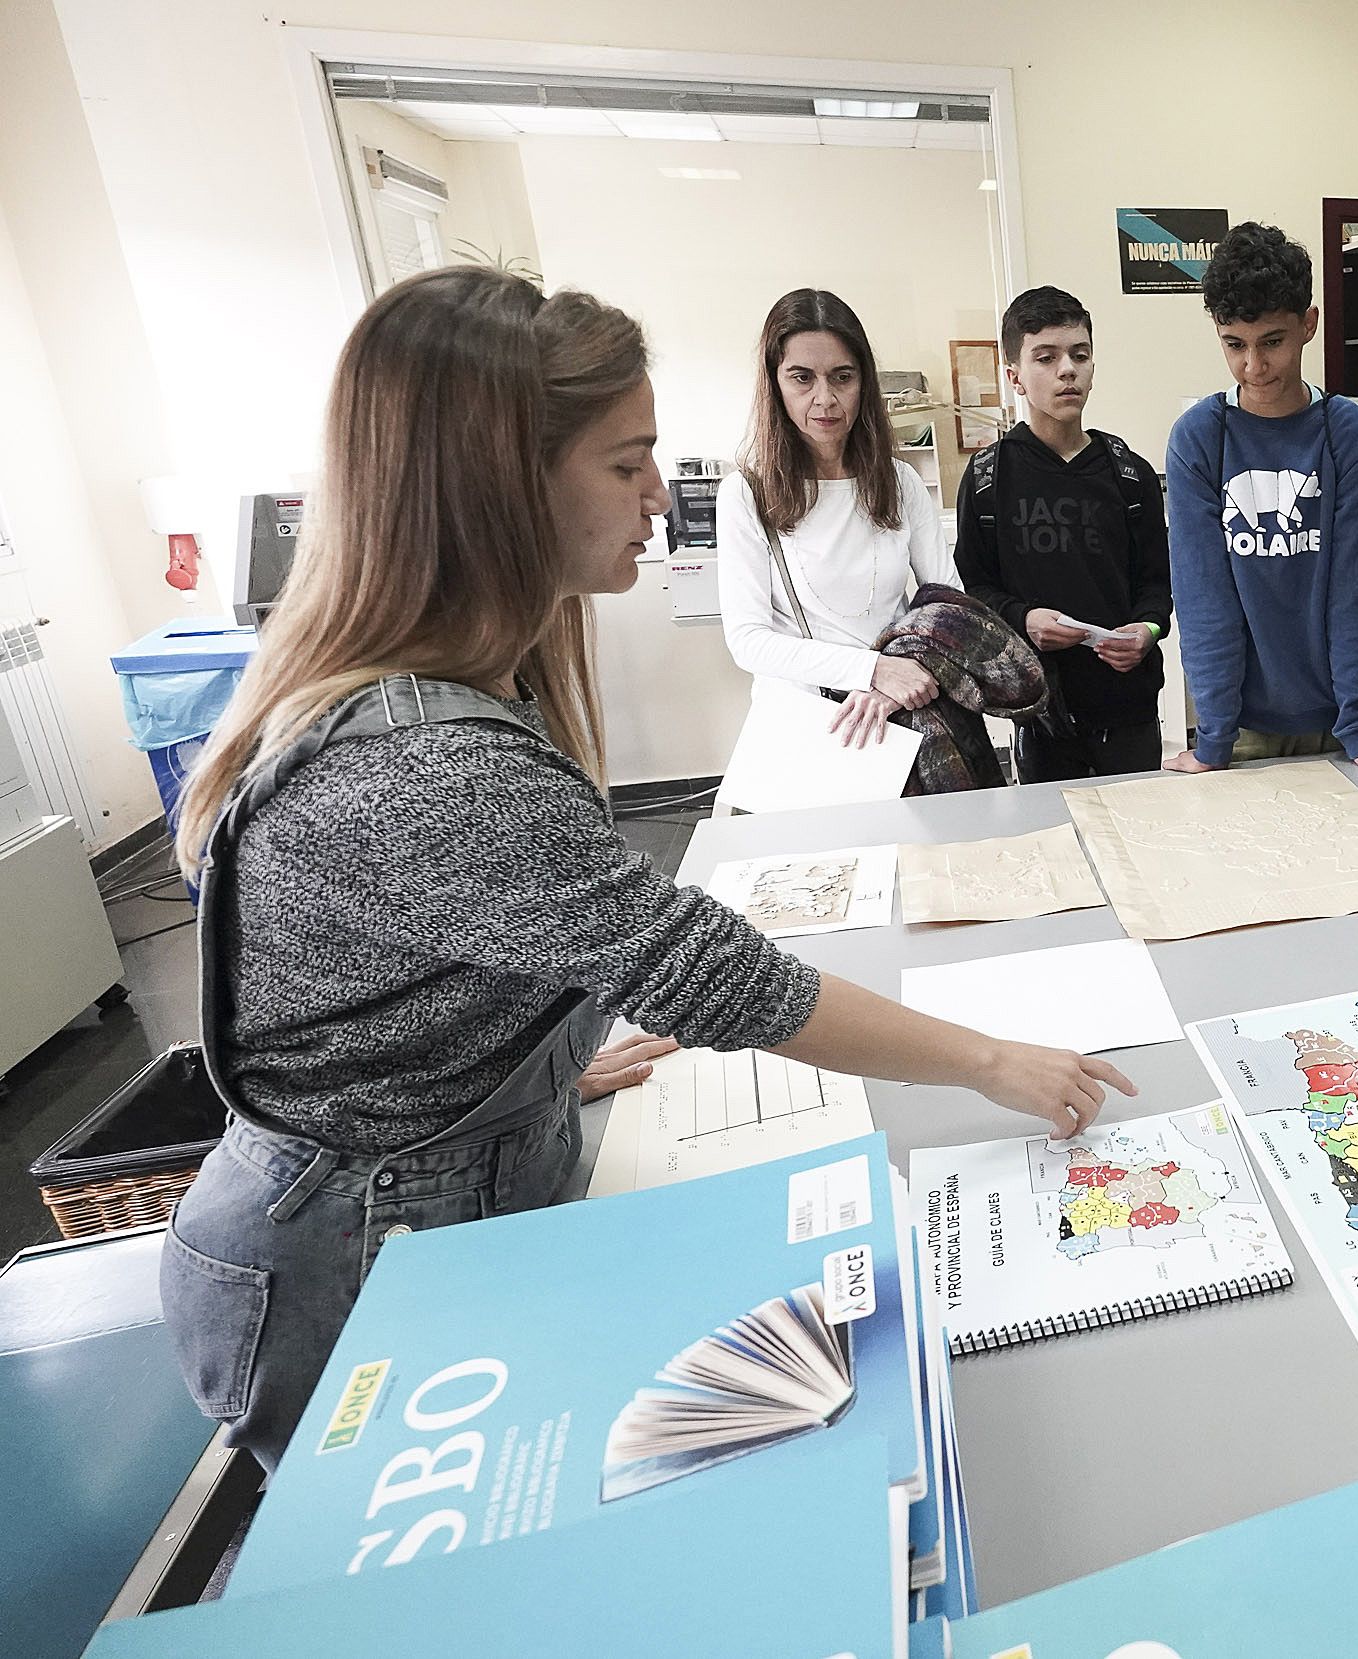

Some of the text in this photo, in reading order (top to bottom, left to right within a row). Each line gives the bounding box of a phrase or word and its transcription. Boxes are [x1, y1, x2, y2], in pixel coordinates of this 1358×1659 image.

[1128, 242, 1181, 263] NUNCA
[1012, 497, 1101, 526] JACK
[1234, 1059, 1260, 1087] FRANCIA
[1295, 1151, 1309, 1164] CAN
[1279, 1166, 1292, 1179] MAR
[1309, 1191, 1323, 1204] PAS
[1341, 1187, 1354, 1198] AS
[943, 1173, 962, 1310] Y PROVINCIAL DE ESPAÑA
[988, 1192, 1005, 1267] GUÍA DE CLAVES
[847, 1251, 866, 1297] ONCE
[340, 1367, 381, 1424] ONCE
